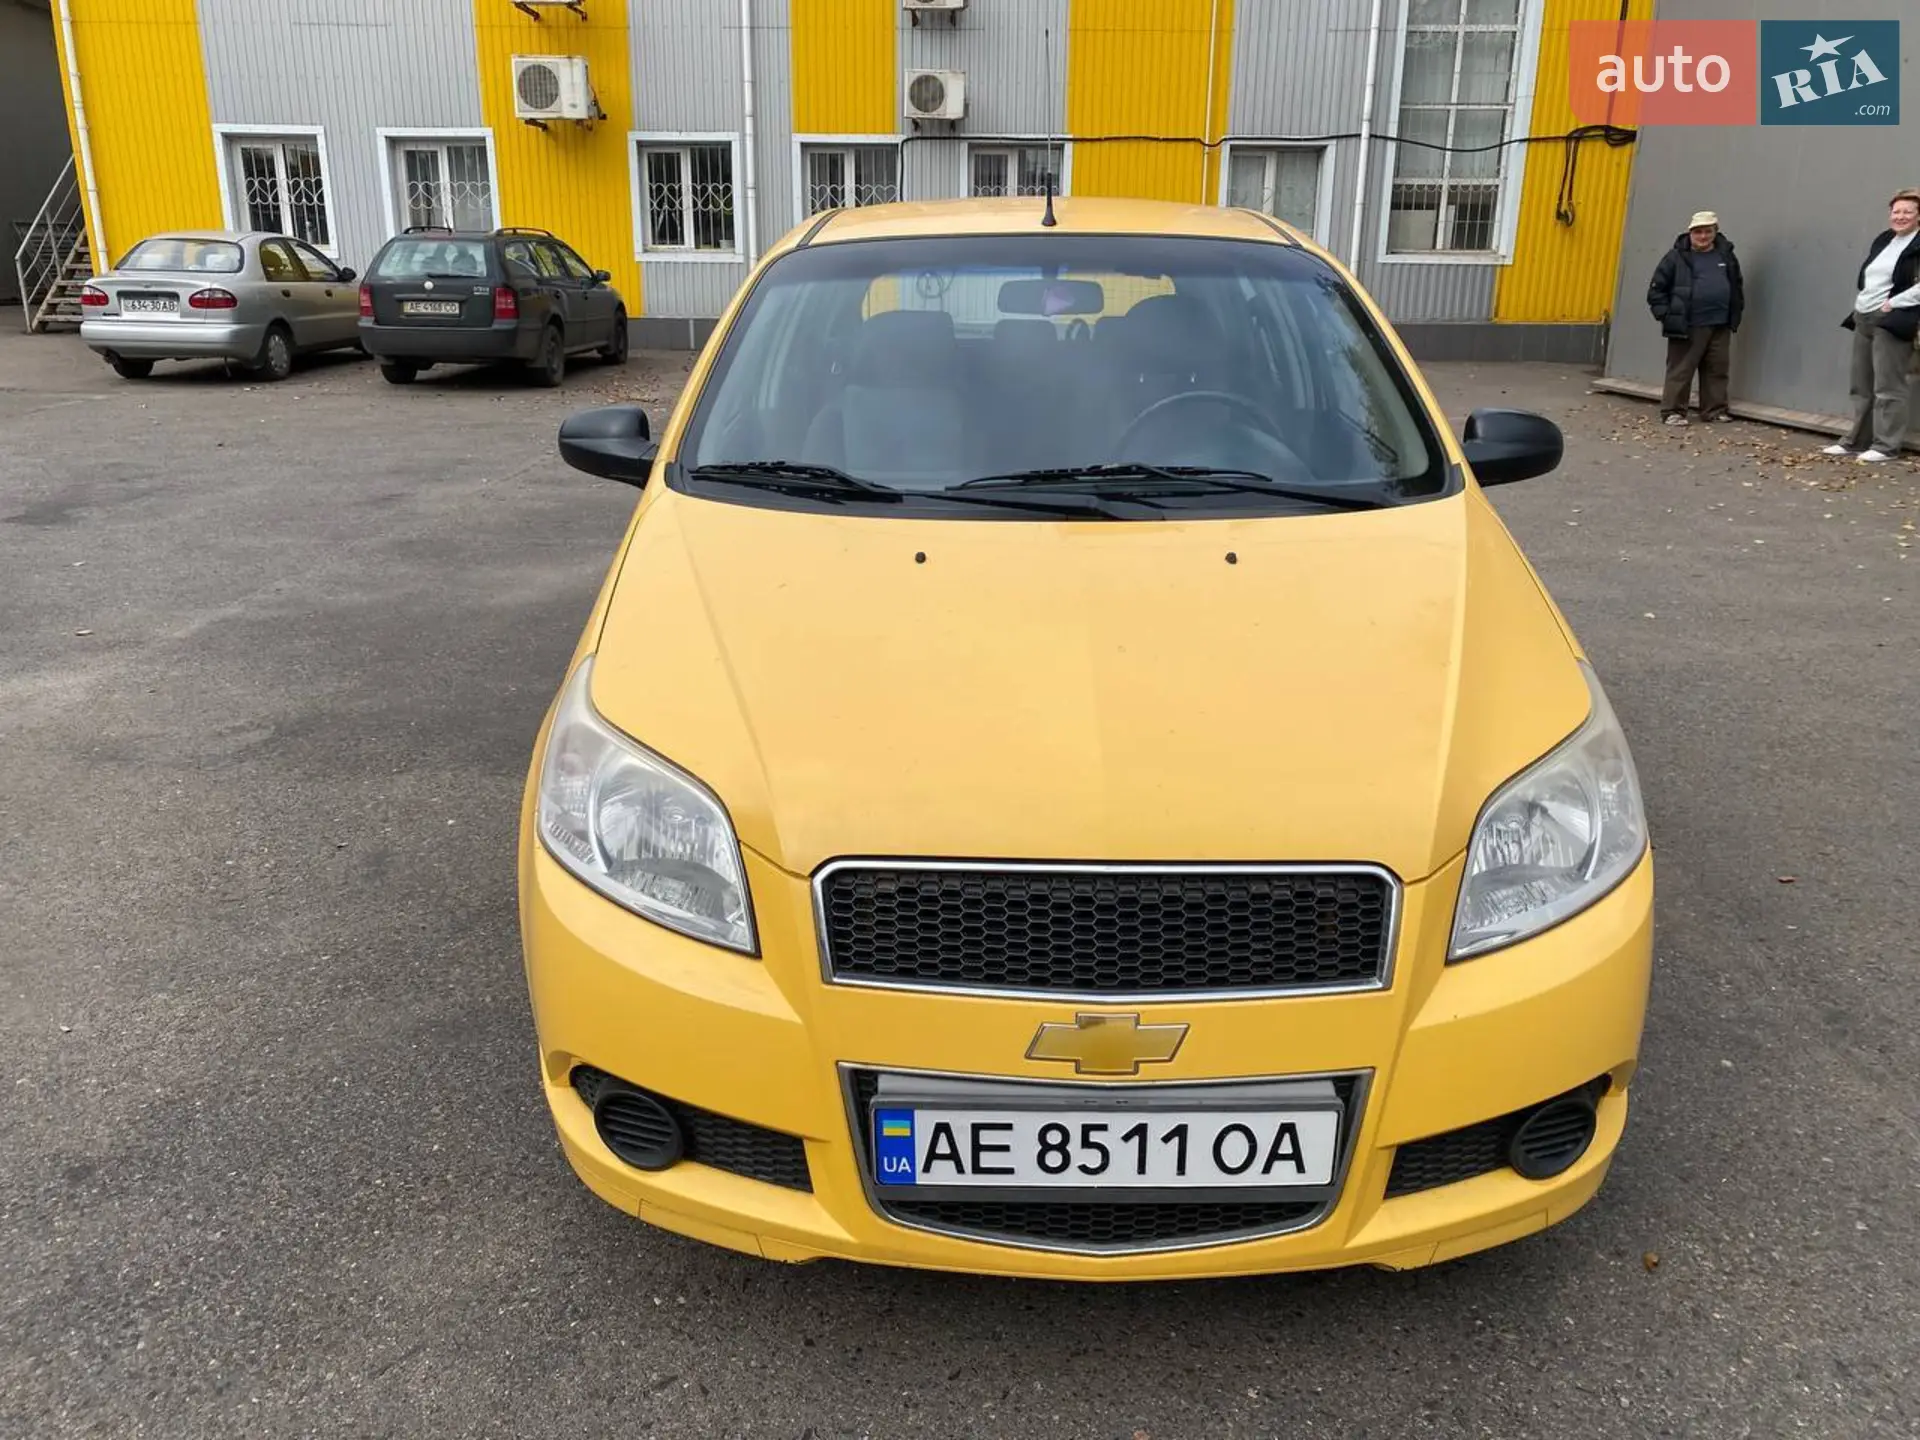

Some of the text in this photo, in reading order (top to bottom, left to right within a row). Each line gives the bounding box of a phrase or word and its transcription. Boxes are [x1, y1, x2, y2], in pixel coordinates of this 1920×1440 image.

[883, 1156, 912, 1173] UA
[921, 1121, 1306, 1176] AE 8511 OA
